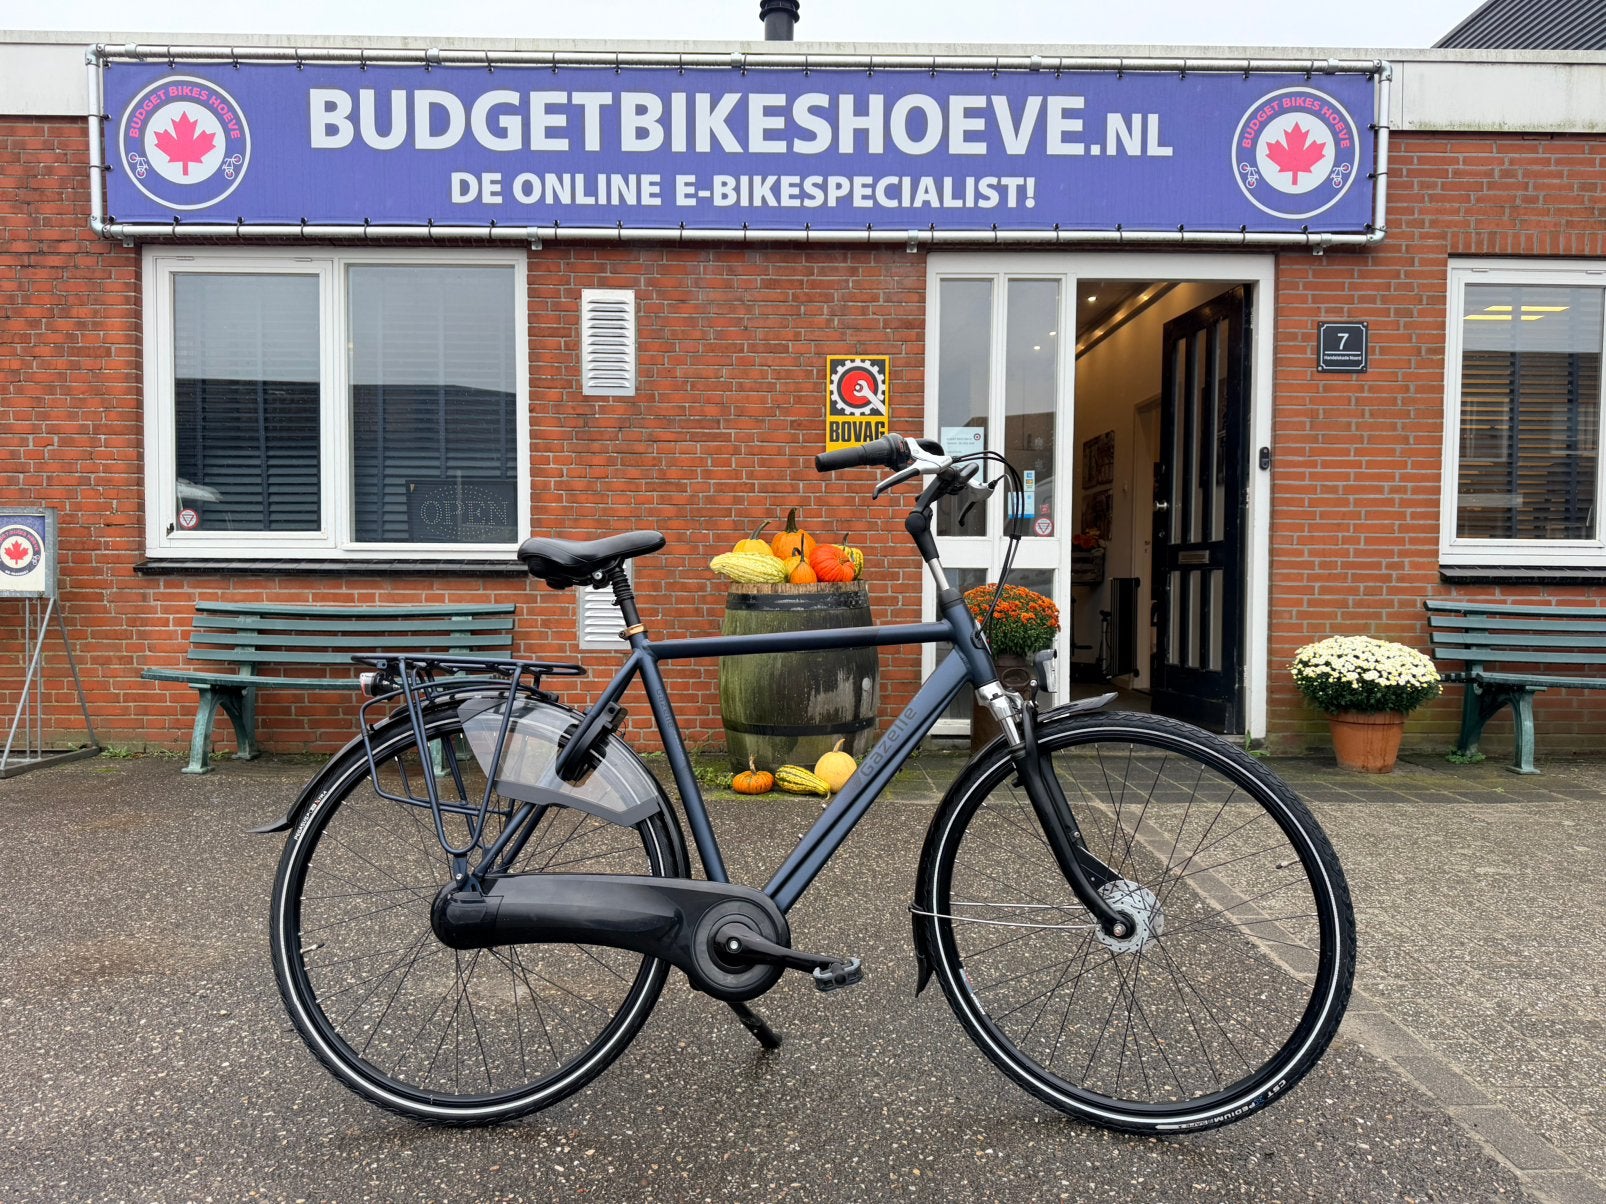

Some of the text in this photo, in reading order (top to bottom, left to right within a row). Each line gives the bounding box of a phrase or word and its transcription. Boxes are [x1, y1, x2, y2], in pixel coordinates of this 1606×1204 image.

[129, 85, 241, 139] BUDGET BIKES HOEVE
[309, 88, 1173, 156] BUDGETBIKESHOEVE.NL
[1242, 97, 1351, 149] BUDGET BIKES HOEVE
[451, 172, 1036, 208] DE ONLINE E-BIKESPECIALIST!
[1337, 333, 1350, 350] 7
[829, 421, 886, 443] BOVAG
[420, 500, 509, 525] OPEN
[860, 707, 917, 777] Gazelle
[1268, 1079, 1287, 1098] CST
